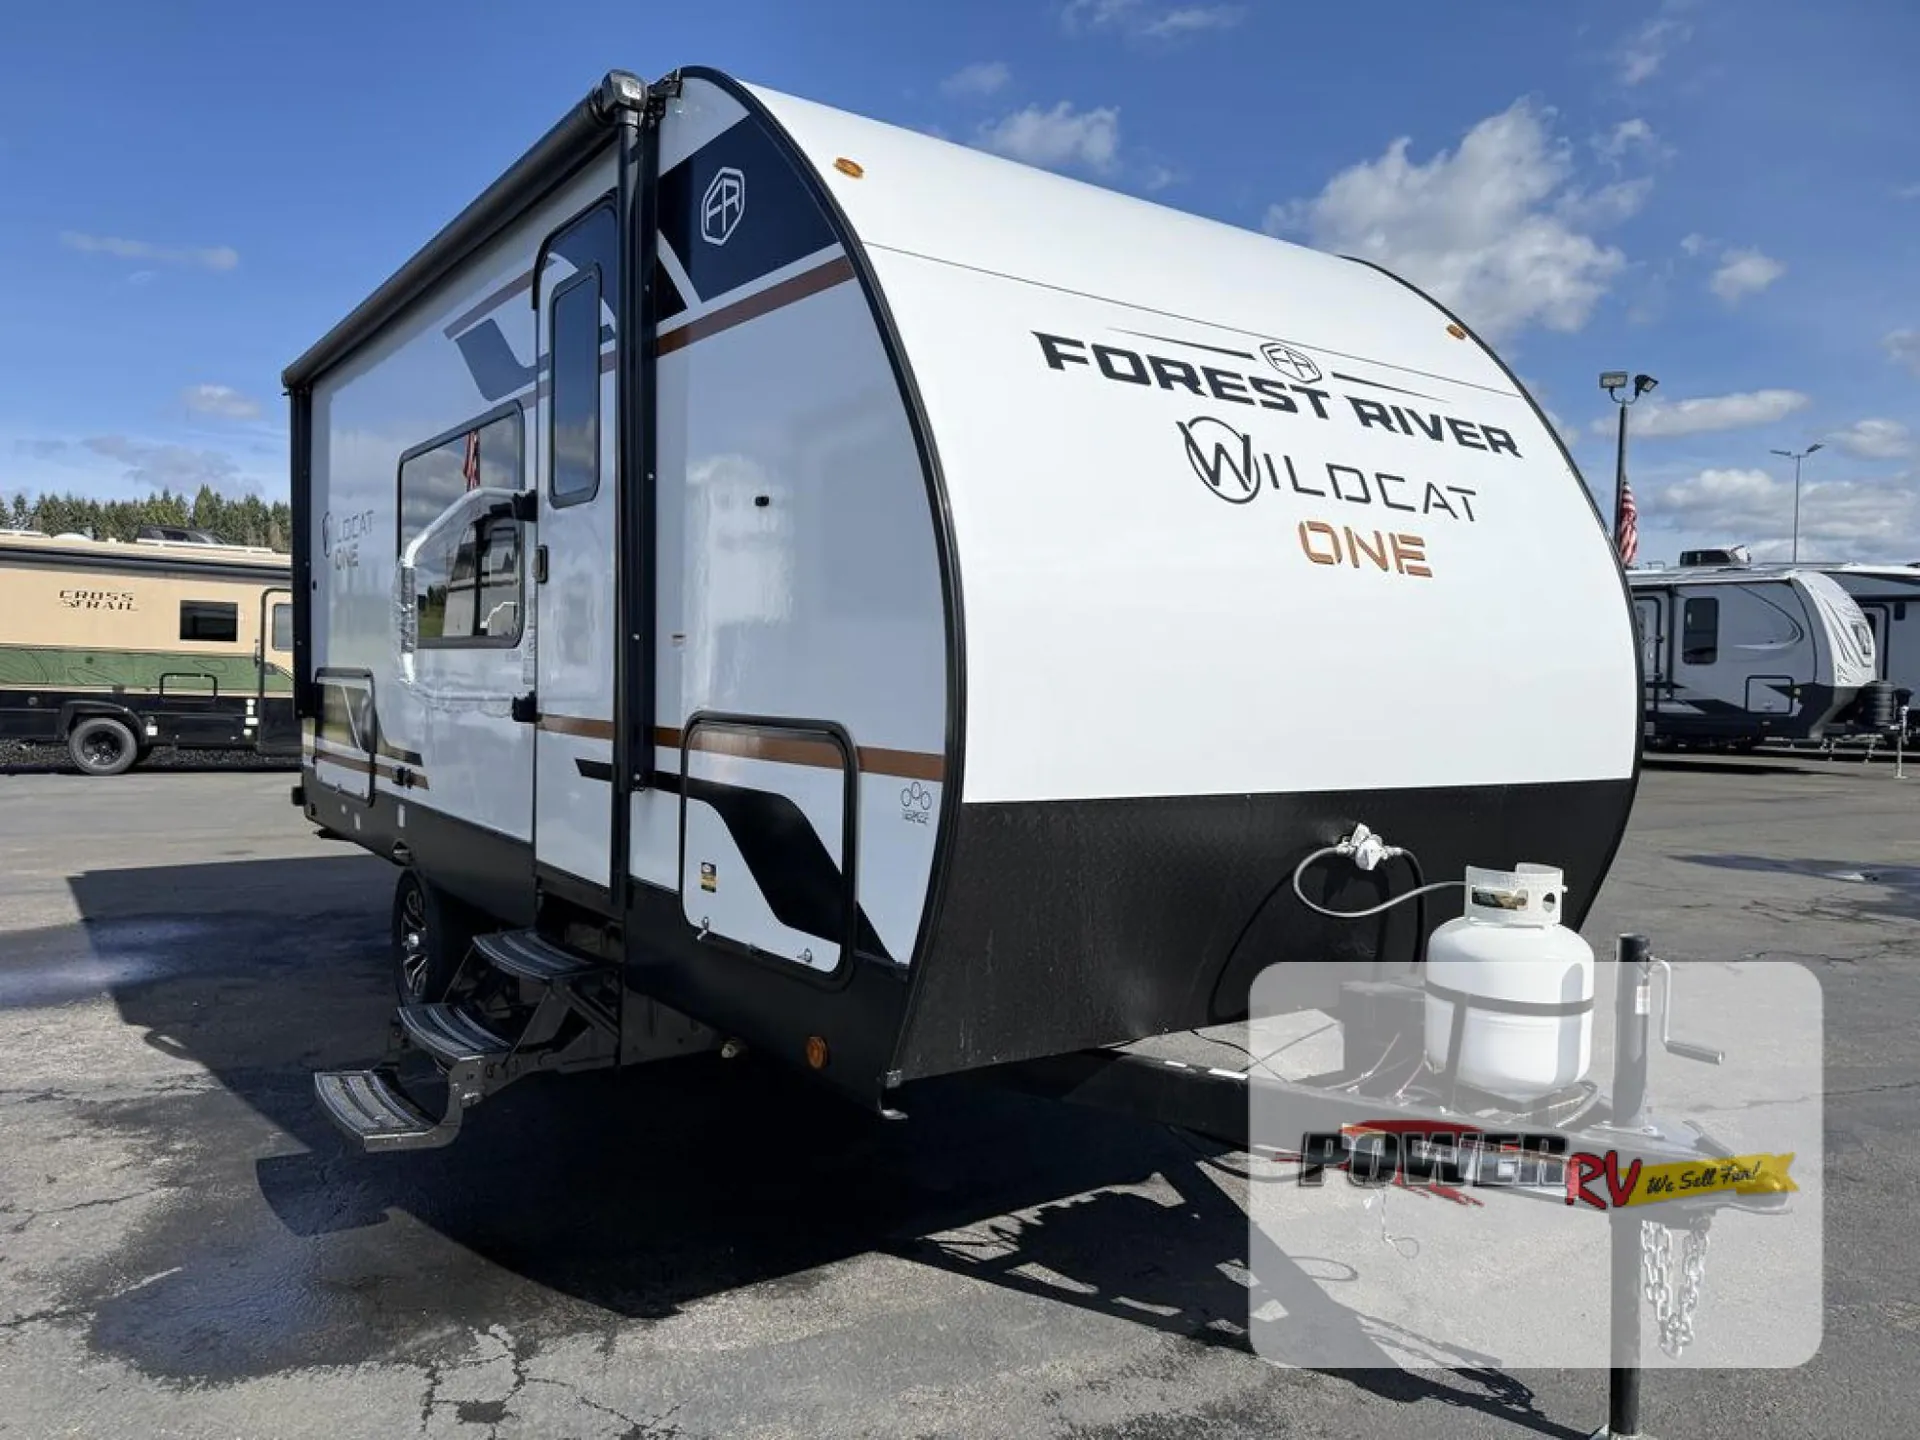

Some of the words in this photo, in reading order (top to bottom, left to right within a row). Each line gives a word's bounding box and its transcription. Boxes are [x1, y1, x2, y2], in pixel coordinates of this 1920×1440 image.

[1031, 331, 1330, 419] FOREST
[1346, 395, 1523, 458] RIVER
[1298, 520, 1433, 578] ONE
[59, 589, 134, 601] CROSS
